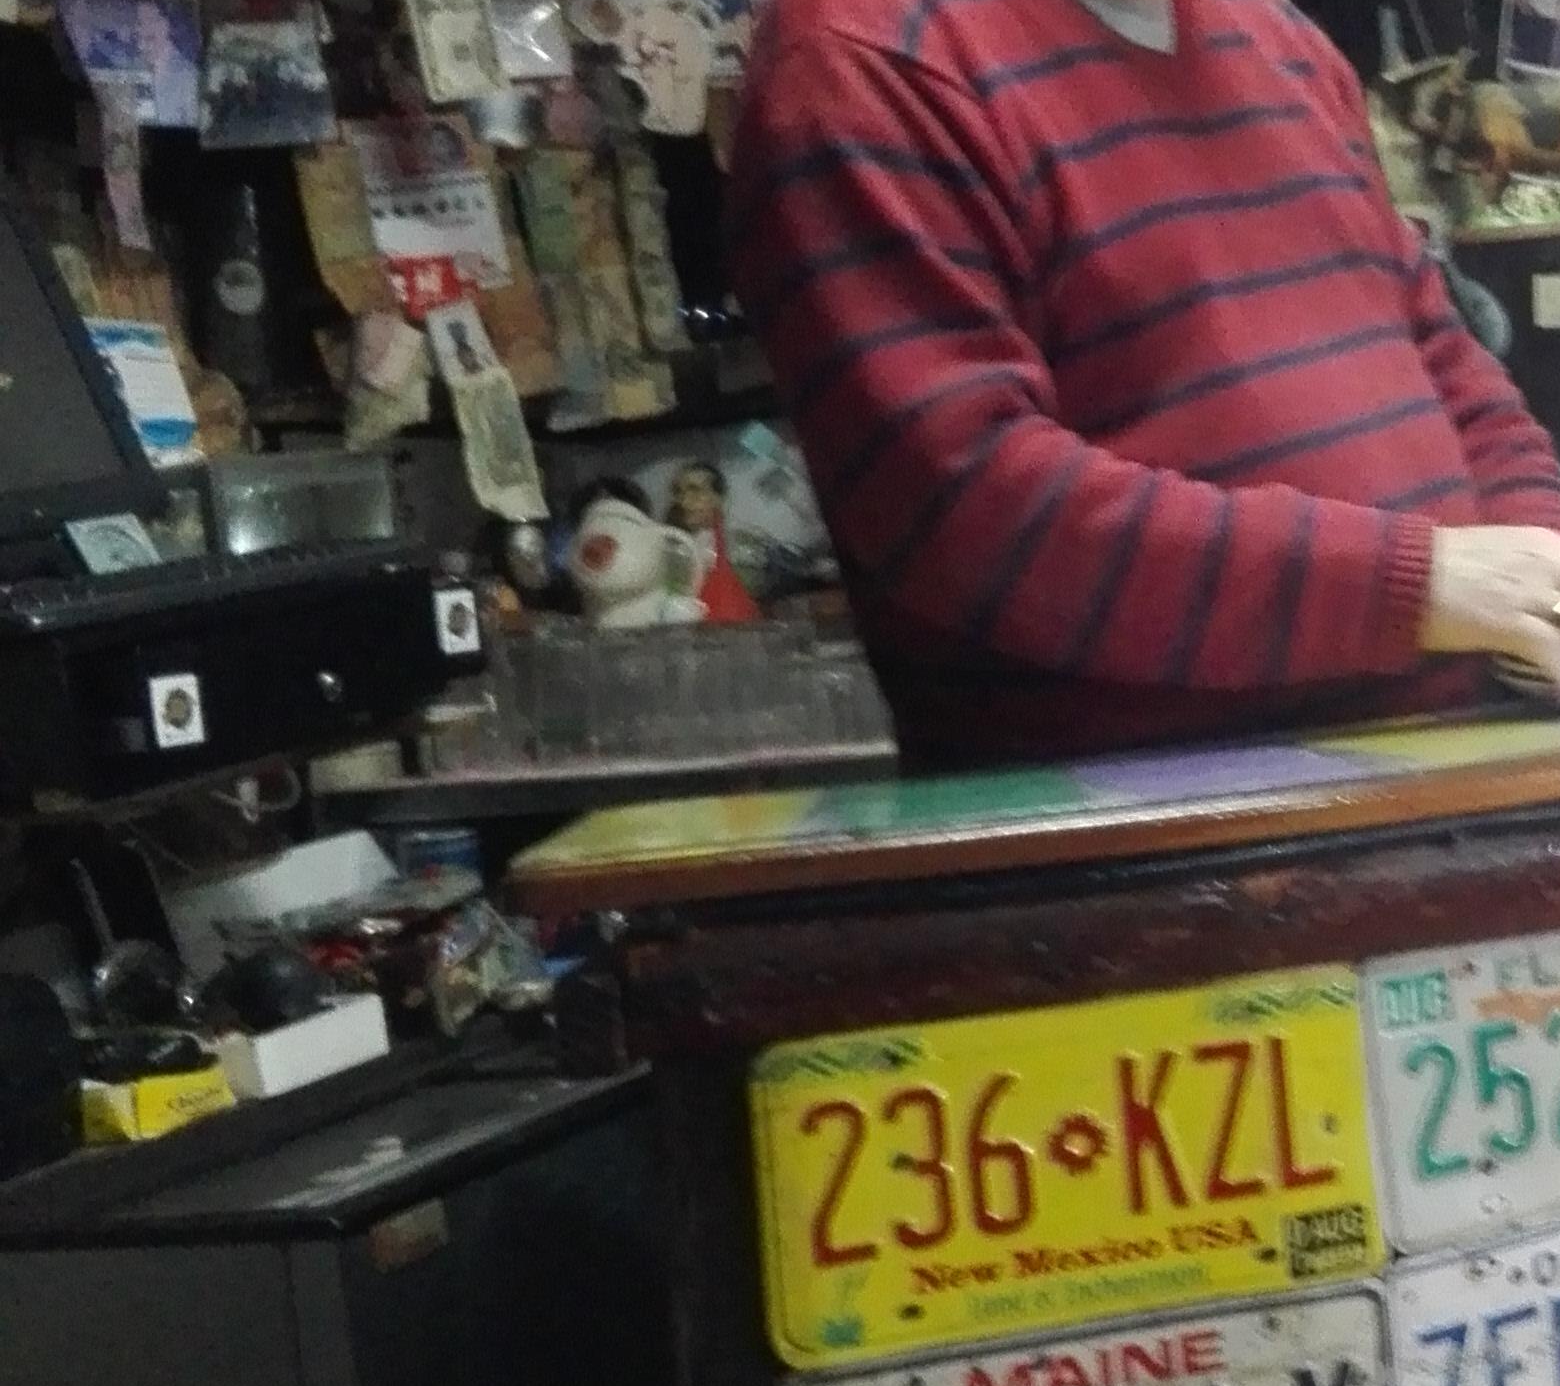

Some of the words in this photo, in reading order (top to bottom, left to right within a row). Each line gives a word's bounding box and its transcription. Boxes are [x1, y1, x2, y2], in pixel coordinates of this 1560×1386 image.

[800, 1070, 1037, 1270] 236
[1117, 1034, 1341, 1216] KZL
[909, 1261, 999, 1294] New
[1011, 1234, 1163, 1279] Mexico
